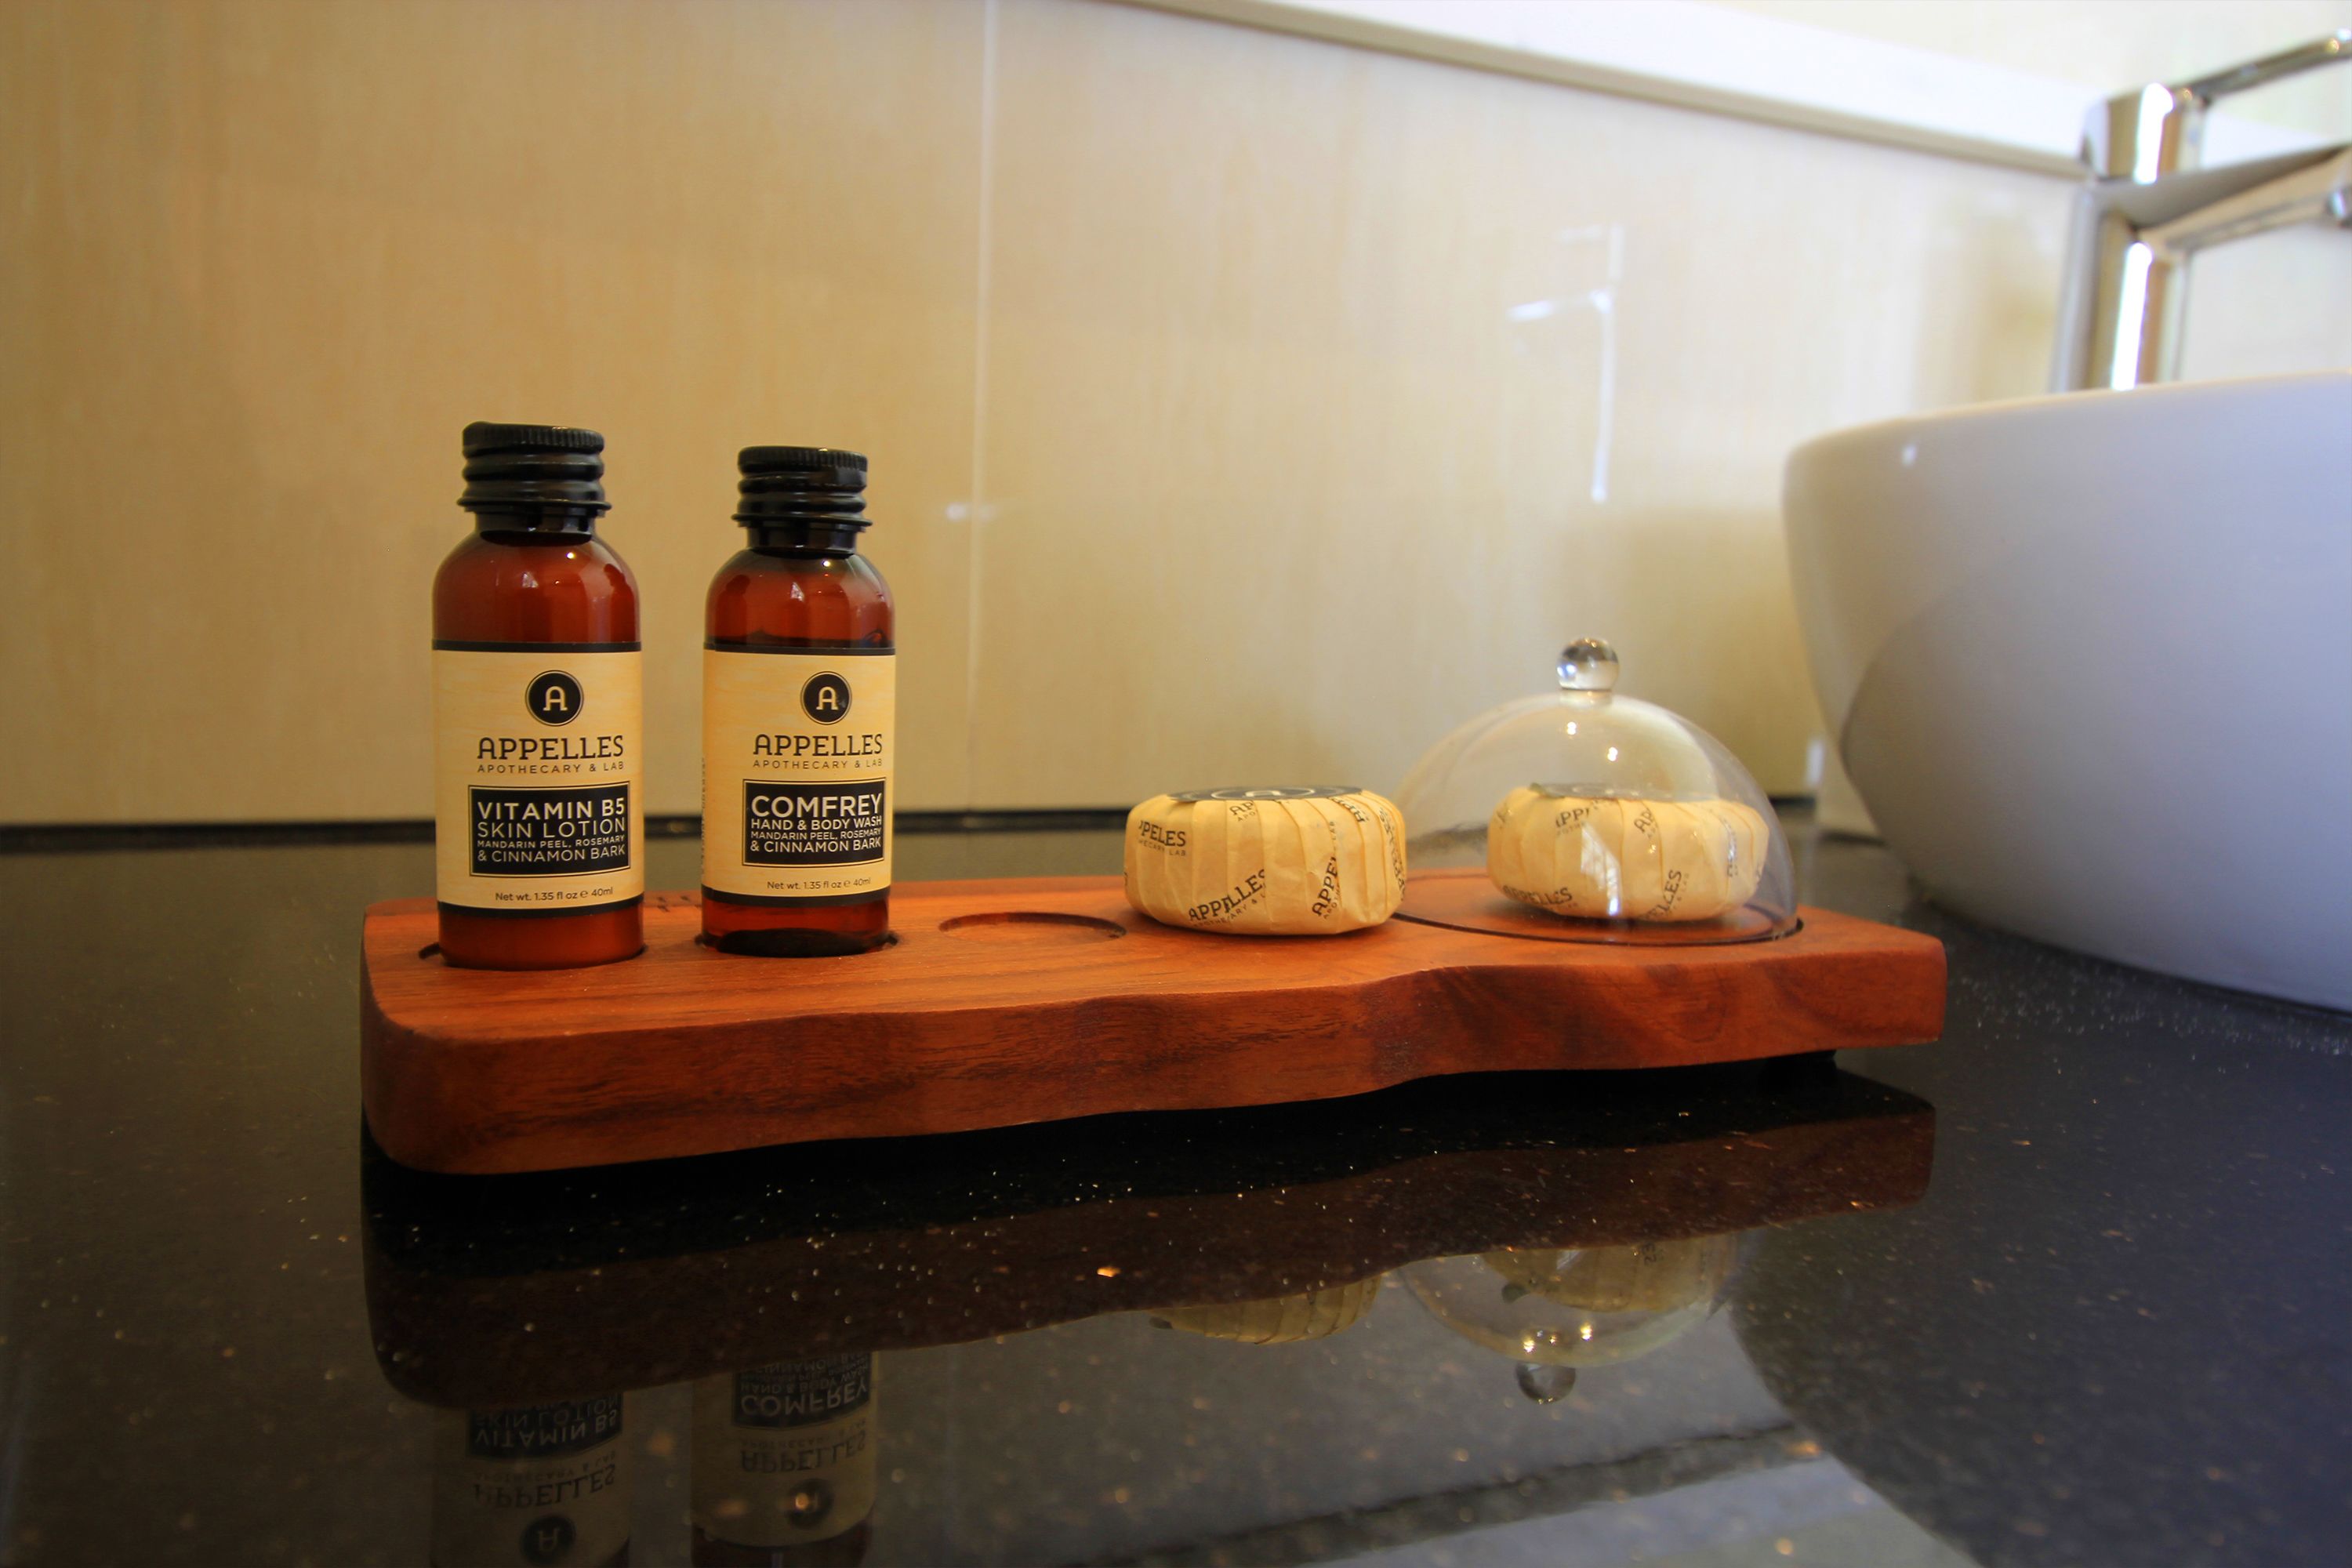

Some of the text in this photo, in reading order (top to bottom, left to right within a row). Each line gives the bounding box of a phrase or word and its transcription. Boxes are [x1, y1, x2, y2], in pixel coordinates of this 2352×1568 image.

[543, 685, 568, 712] A
[815, 686, 839, 710] A
[476, 735, 625, 760] APPELLES
[752, 733, 883, 757] APPELLES
[477, 760, 625, 774] APOTHECARY & LAB
[752, 758, 883, 769] APOTHECARY & LAB
[477, 797, 625, 820] VITAMIN B5
[751, 792, 882, 818] COMFREY
[477, 817, 625, 839] SKIN LOTION
[751, 816, 882, 831] HAND & BODY WASH
[477, 834, 626, 849] MANDARIN PEEL, ROSEMARY
[751, 828, 881, 841] MANDARIN PEEL, ROSEMARY
[477, 844, 626, 863] & CINNAMON BARK
[750, 837, 881, 853] & CINNAMON BARK
[768, 880, 784, 889] Net
[786, 881, 801, 890] wt.
[804, 880, 822, 890] 1.35
[823, 880, 829, 888] fl
[853, 877, 872, 887] 40ml
[495, 891, 514, 901] Net
[516, 892, 532, 901] wt.
[534, 891, 554, 901] 1.35
[557, 891, 564, 900] fl
[565, 891, 579, 900] oz
[591, 886, 614, 897] 40ml
